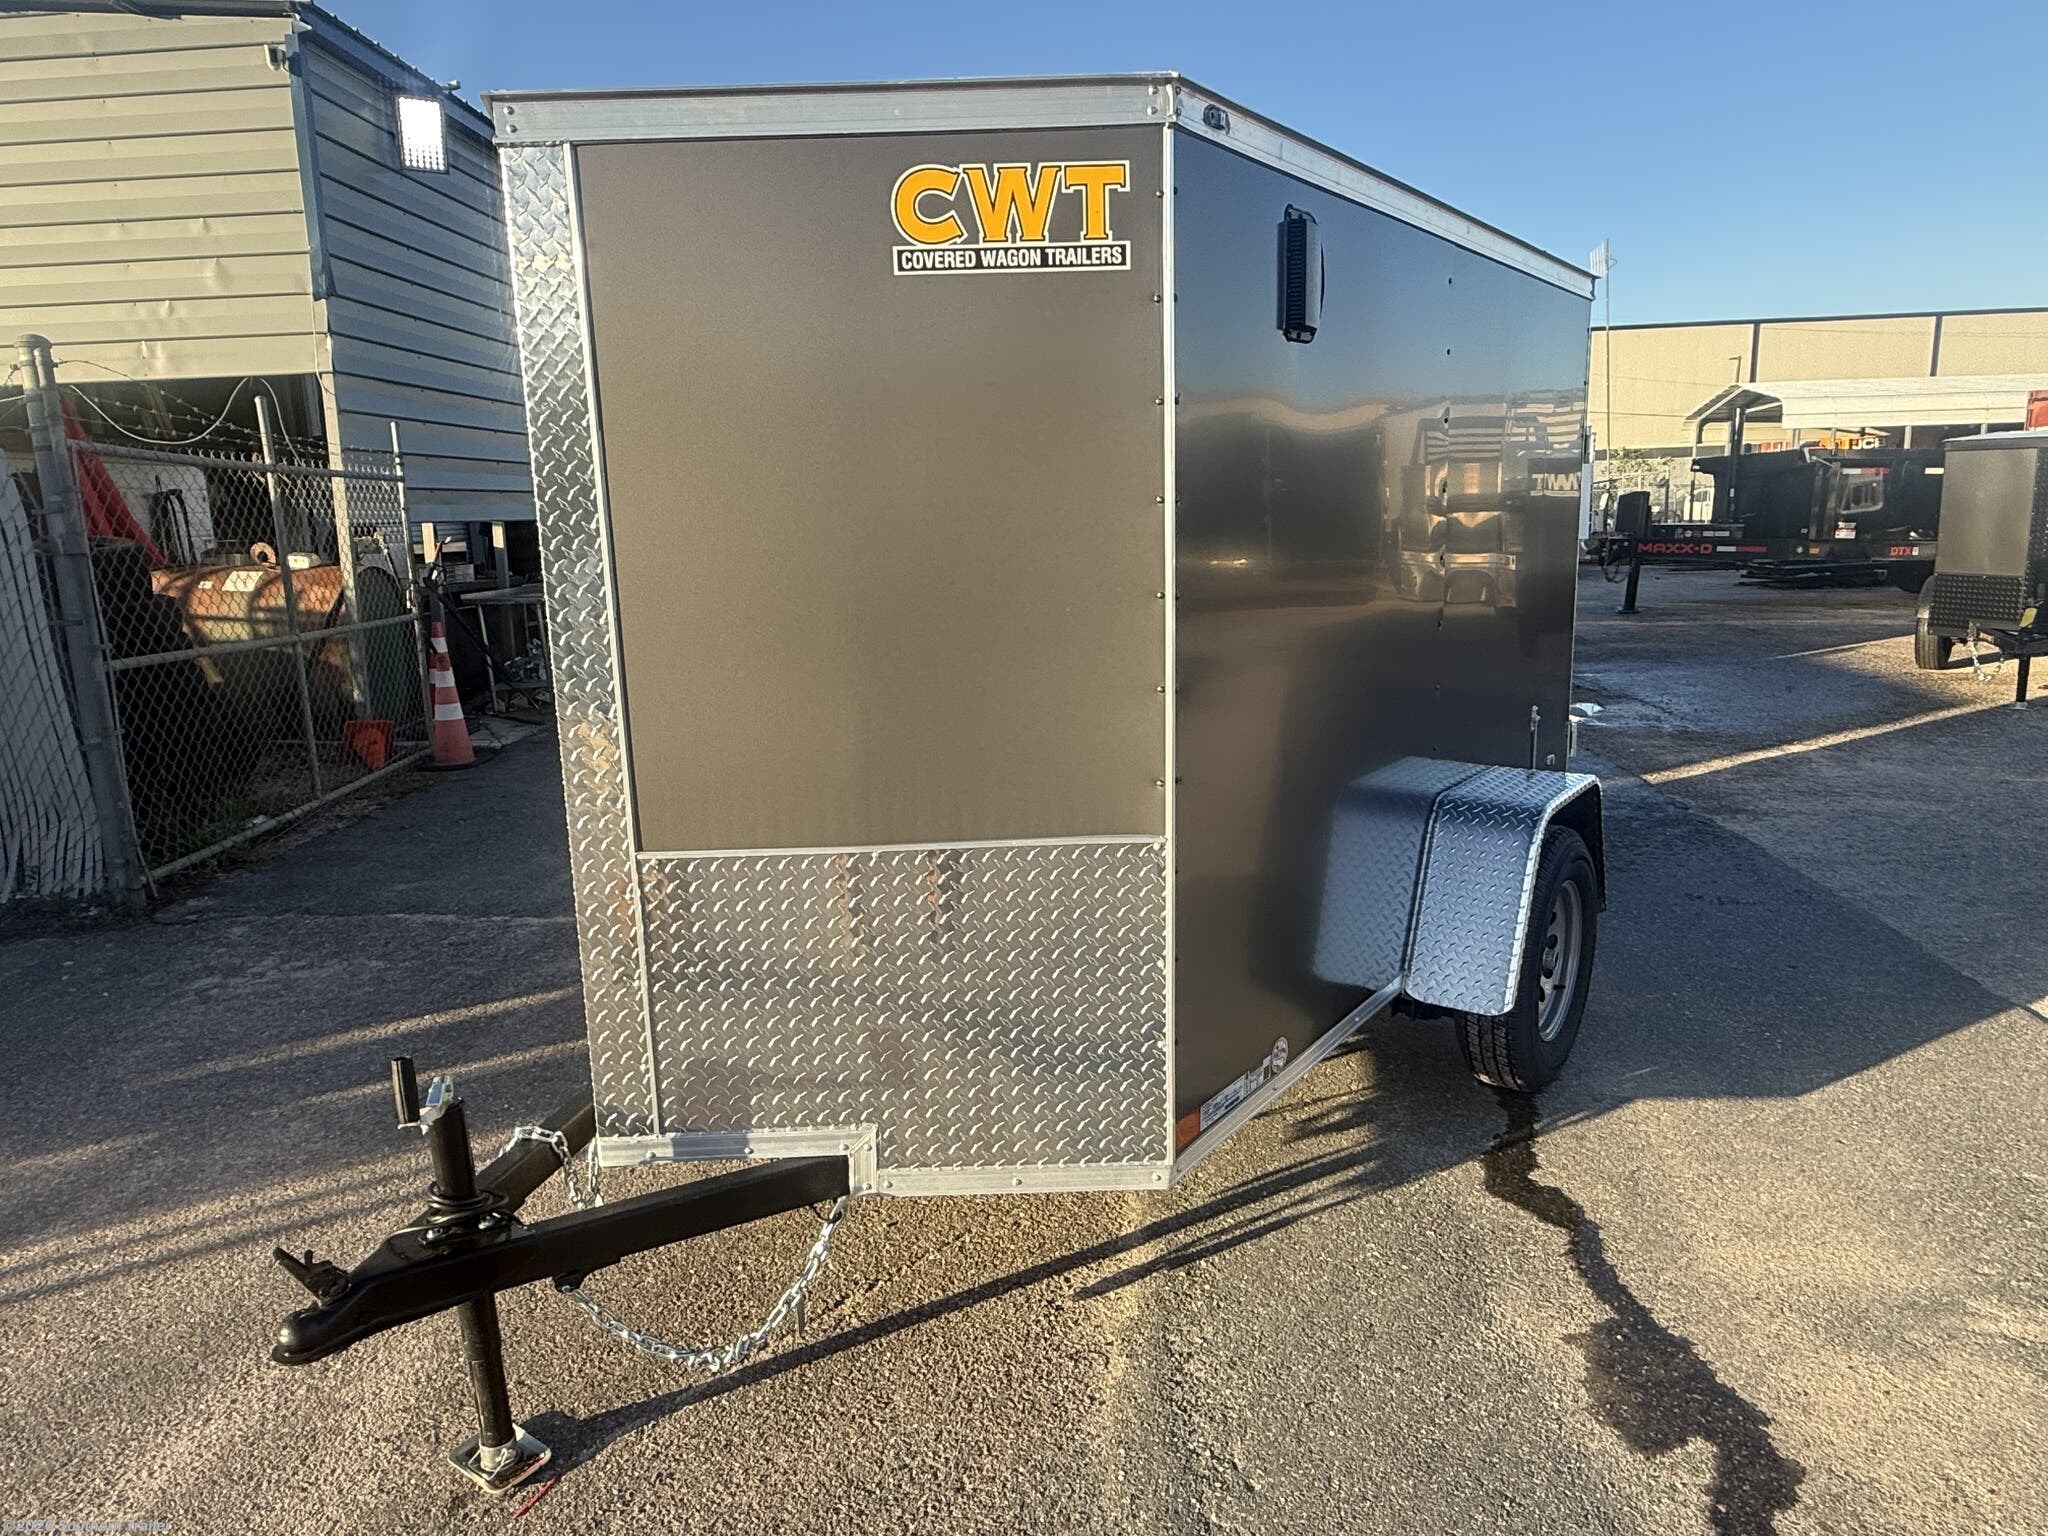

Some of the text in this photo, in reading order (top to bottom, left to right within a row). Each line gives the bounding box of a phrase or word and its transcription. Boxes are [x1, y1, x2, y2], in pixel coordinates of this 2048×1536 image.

[892, 162, 1129, 245] CWT
[901, 246, 1122, 270] COVERED WAGON TRAILERS
